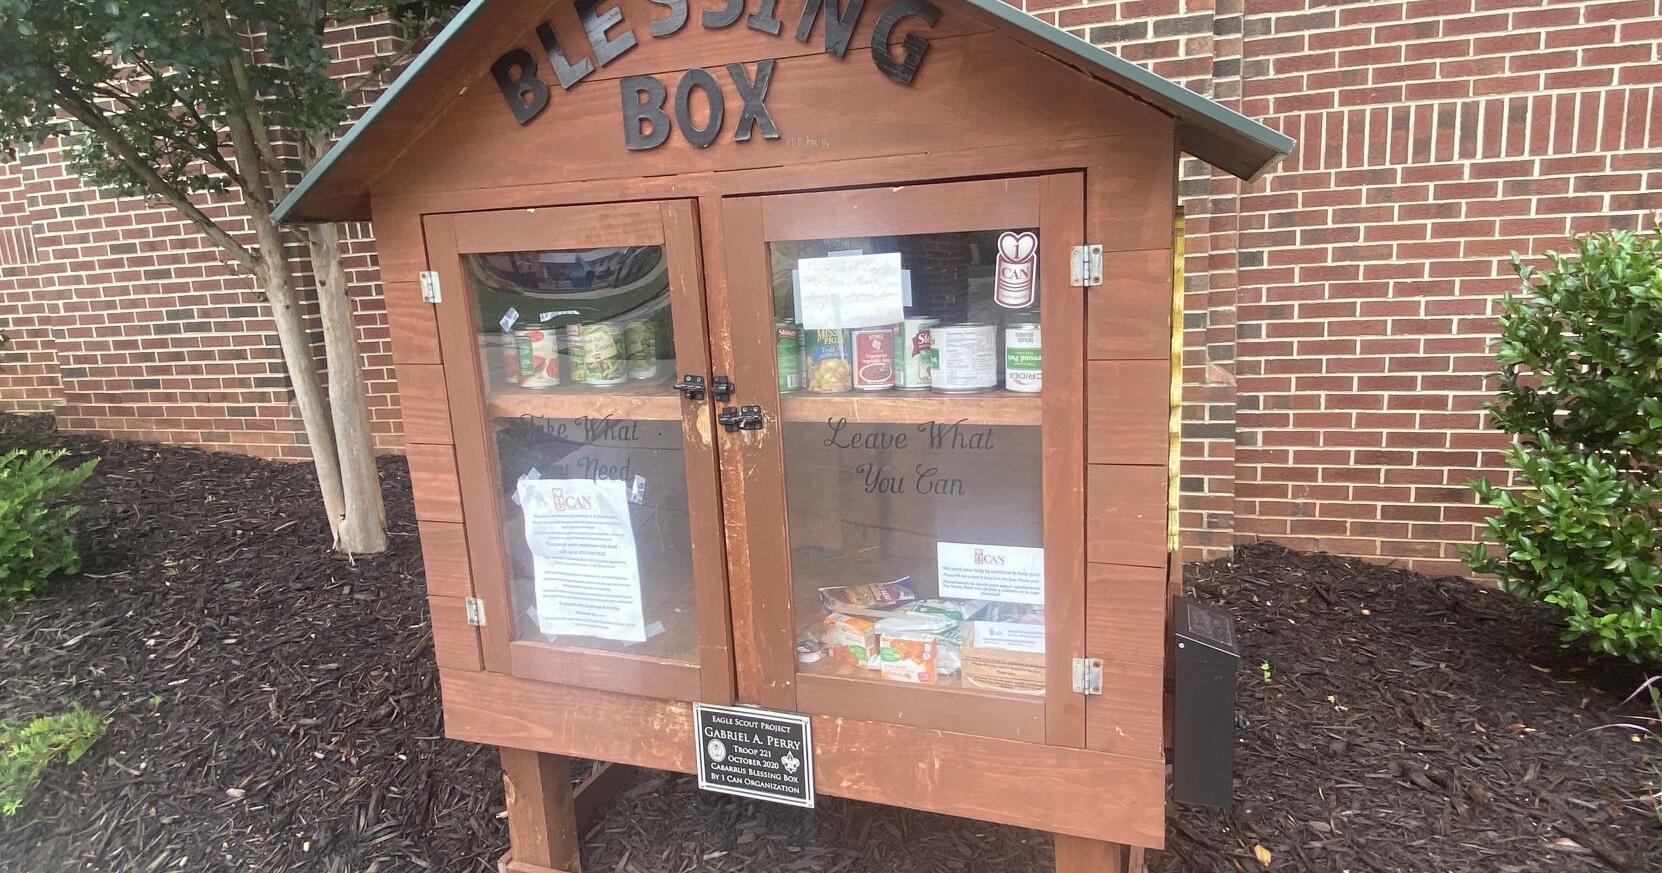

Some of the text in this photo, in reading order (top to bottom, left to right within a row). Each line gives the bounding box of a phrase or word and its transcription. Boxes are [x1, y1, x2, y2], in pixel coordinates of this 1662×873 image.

[619, 59, 780, 151] BOX
[1013, 243, 1020, 259] 1
[1002, 267, 1029, 280] CAN
[521, 413, 639, 441] Tke What
[824, 416, 994, 450] Leave What
[577, 457, 631, 483] Need
[856, 462, 966, 495] You Can
[565, 495, 592, 511] CAN
[984, 554, 1006, 566] CAN
[712, 715, 791, 733] EAGLE SCOUT PROJECT
[704, 726, 801, 751] GABRIEL A. PERRY
[727, 755, 779, 769] OCTOBER 2020
[733, 745, 772, 758] TROOP 221
[711, 762, 798, 783] CABARRUS BLESSING BOX
[711, 773, 719, 781] BY
[726, 775, 742, 784] CAN
[744, 778, 800, 794] ORGANIZATION
